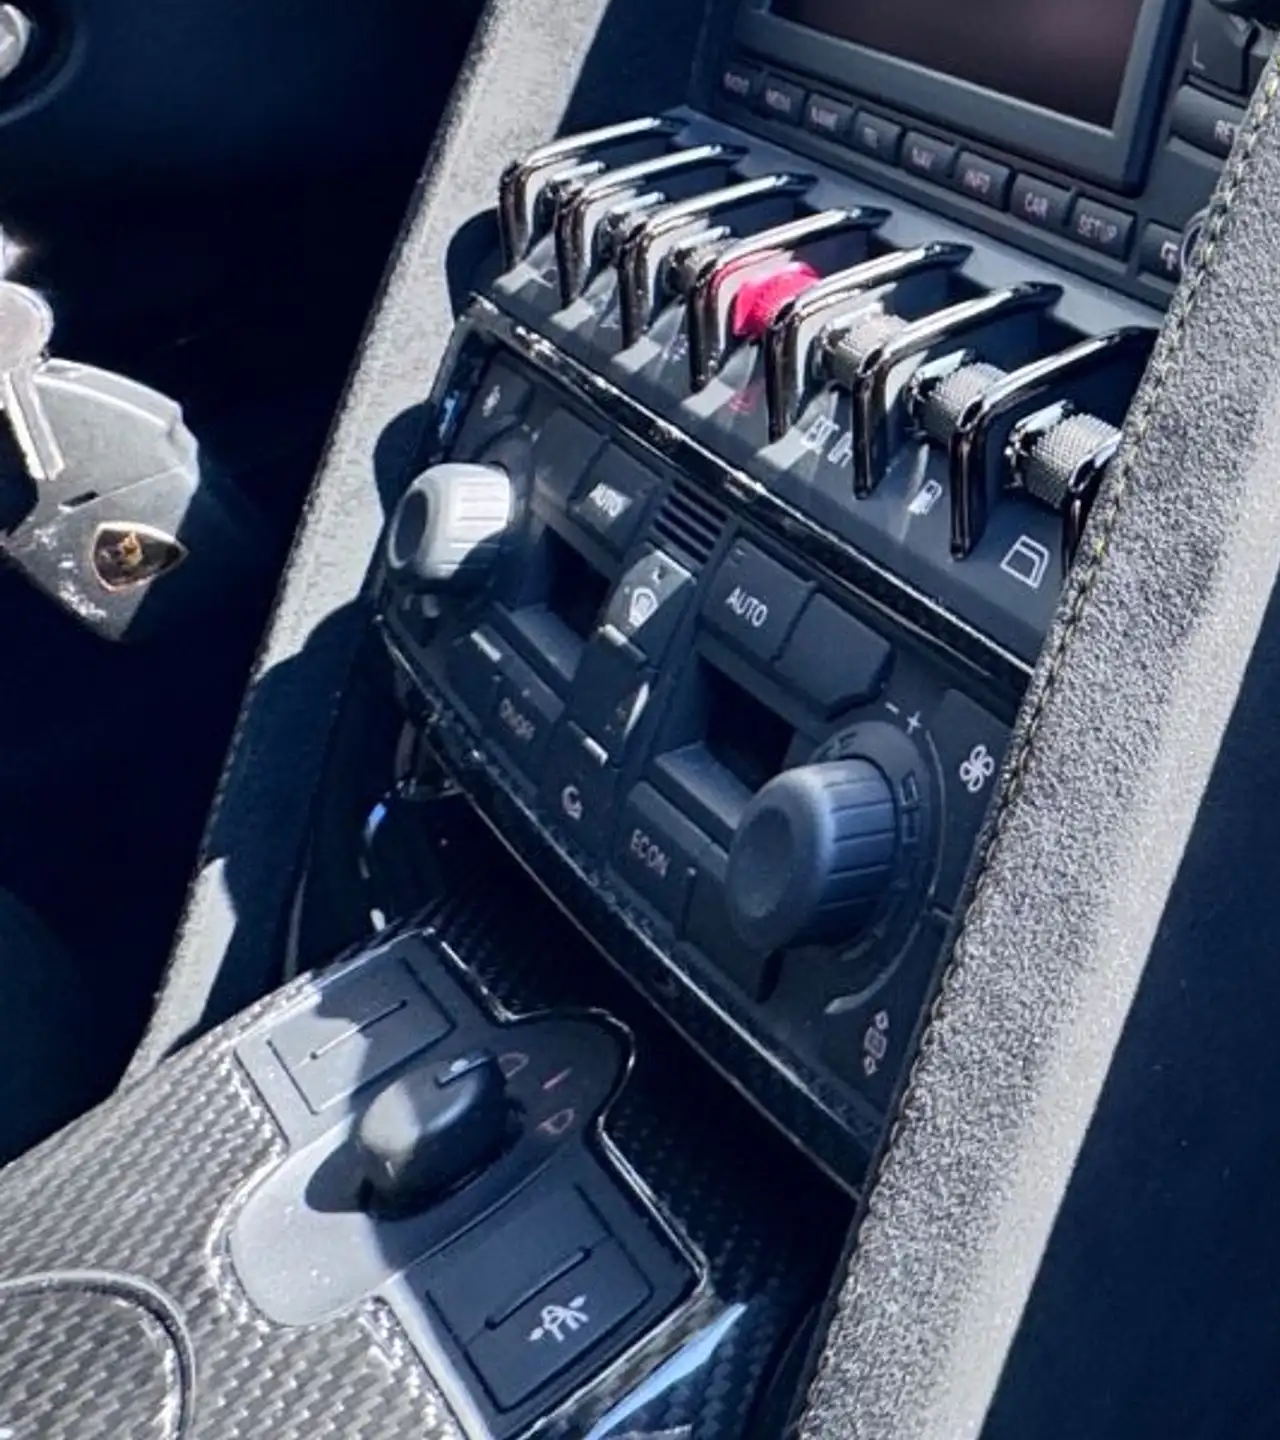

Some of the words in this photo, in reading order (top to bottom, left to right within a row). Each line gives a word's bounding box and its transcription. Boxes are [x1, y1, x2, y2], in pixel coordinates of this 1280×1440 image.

[1077, 213, 1118, 244] SETUP
[725, 584, 768, 627] AUTO
[631, 828, 669, 877] ECON
